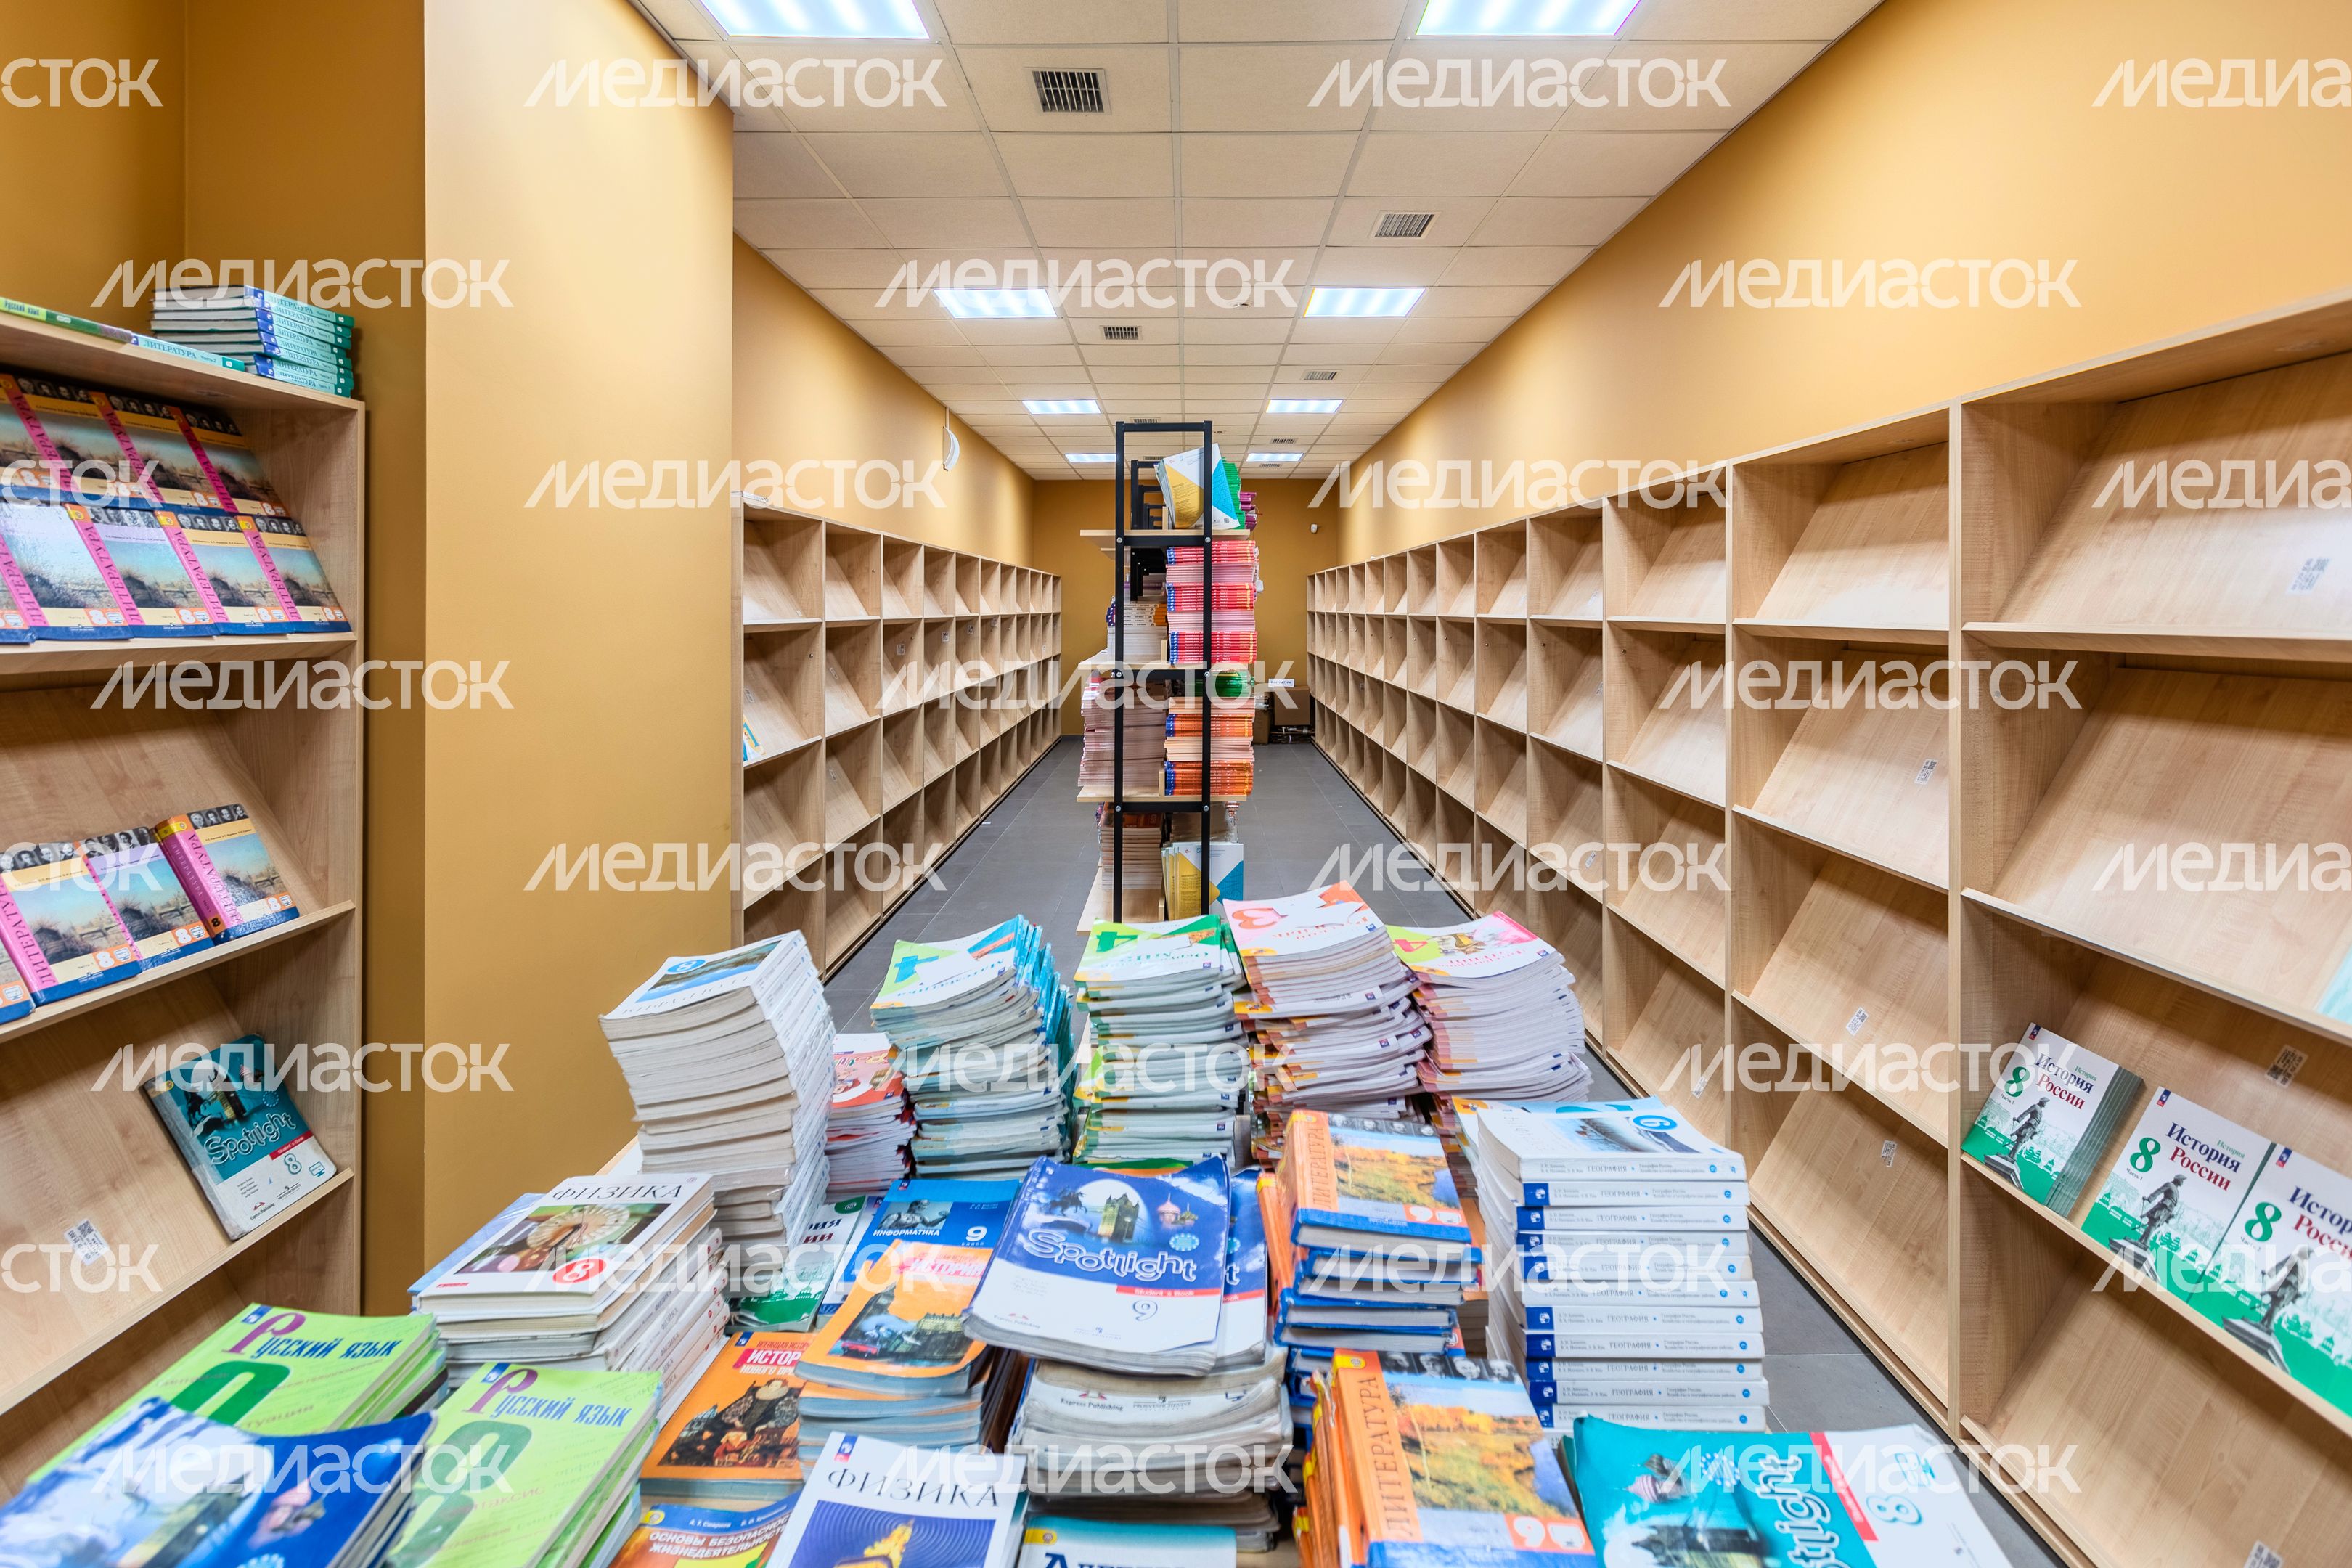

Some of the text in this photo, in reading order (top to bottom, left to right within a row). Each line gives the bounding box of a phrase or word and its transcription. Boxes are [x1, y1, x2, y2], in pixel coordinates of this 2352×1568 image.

[277, 317, 315, 335] ЛИТЕРАТУРА
[277, 328, 314, 346] ЛИТЕРАТУРА
[143, 340, 197, 359] ЛИТЕРАТУРА
[281, 340, 318, 357] ЛИТЕРАТУРА
[193, 492, 208, 506] 8
[262, 502, 276, 515] 8
[85, 526, 143, 624] ЛИТЕРАТУРА
[175, 531, 229, 622] ЛИТЕРАТУРА
[253, 535, 301, 621] ЛИТЕРАТУРА
[89, 609, 108, 625] 8
[179, 609, 196, 624] 8
[257, 608, 272, 622] 8
[323, 608, 335, 621] 8
[188, 833, 242, 923] ЛИТЕРАТУРА
[267, 897, 282, 911] 8
[211, 917, 221, 927] 8
[175, 928, 192, 944] 8
[97, 951, 115, 968] 8
[2004, 1066, 2030, 1098] 8
[2035, 1053, 2095, 1094] История
[2074, 1066, 2098, 1082] История
[2001, 1093, 2012, 1103] Часть
[2035, 1073, 2086, 1110] России
[204, 1111, 297, 1165] Spotlight
[2165, 1122, 2242, 1174] История
[2129, 1136, 2162, 1173] 8
[2216, 1139, 2245, 1159] История
[284, 1153, 302, 1175] 8
[1307, 1126, 1333, 1210] ЛИТЕРАТУРА
[2126, 1167, 2140, 1179] Часть
[2169, 1146, 2232, 1191] России
[552, 1184, 682, 1202] ФИЗИКА
[2287, 1185, 2352, 1236] Истор
[2244, 1201, 2282, 1242] 8
[965, 1225, 987, 1242] 9
[1022, 1228, 1198, 1282] Spotlight
[568, 1262, 595, 1284] 8
[1132, 1299, 1159, 1322] 9
[221, 1312, 403, 1359] Русский язык
[739, 1364, 777, 1376] НОВОГО
[462, 1368, 632, 1428] Русский язык
[1060, 1397, 1087, 1408] Express
[1087, 1401, 1124, 1412] Publishing
[1608, 1413, 1650, 1421] ГЕОГРАФИЯ
[1358, 1376, 1414, 1538] ЛИТЕРАТУРА
[828, 1468, 1000, 1508] ФИЗИКА
[1866, 1494, 1923, 1527] 8
[648, 1532, 706, 1547] ОСНОВЫ
[1512, 1516, 1546, 1548] 9
